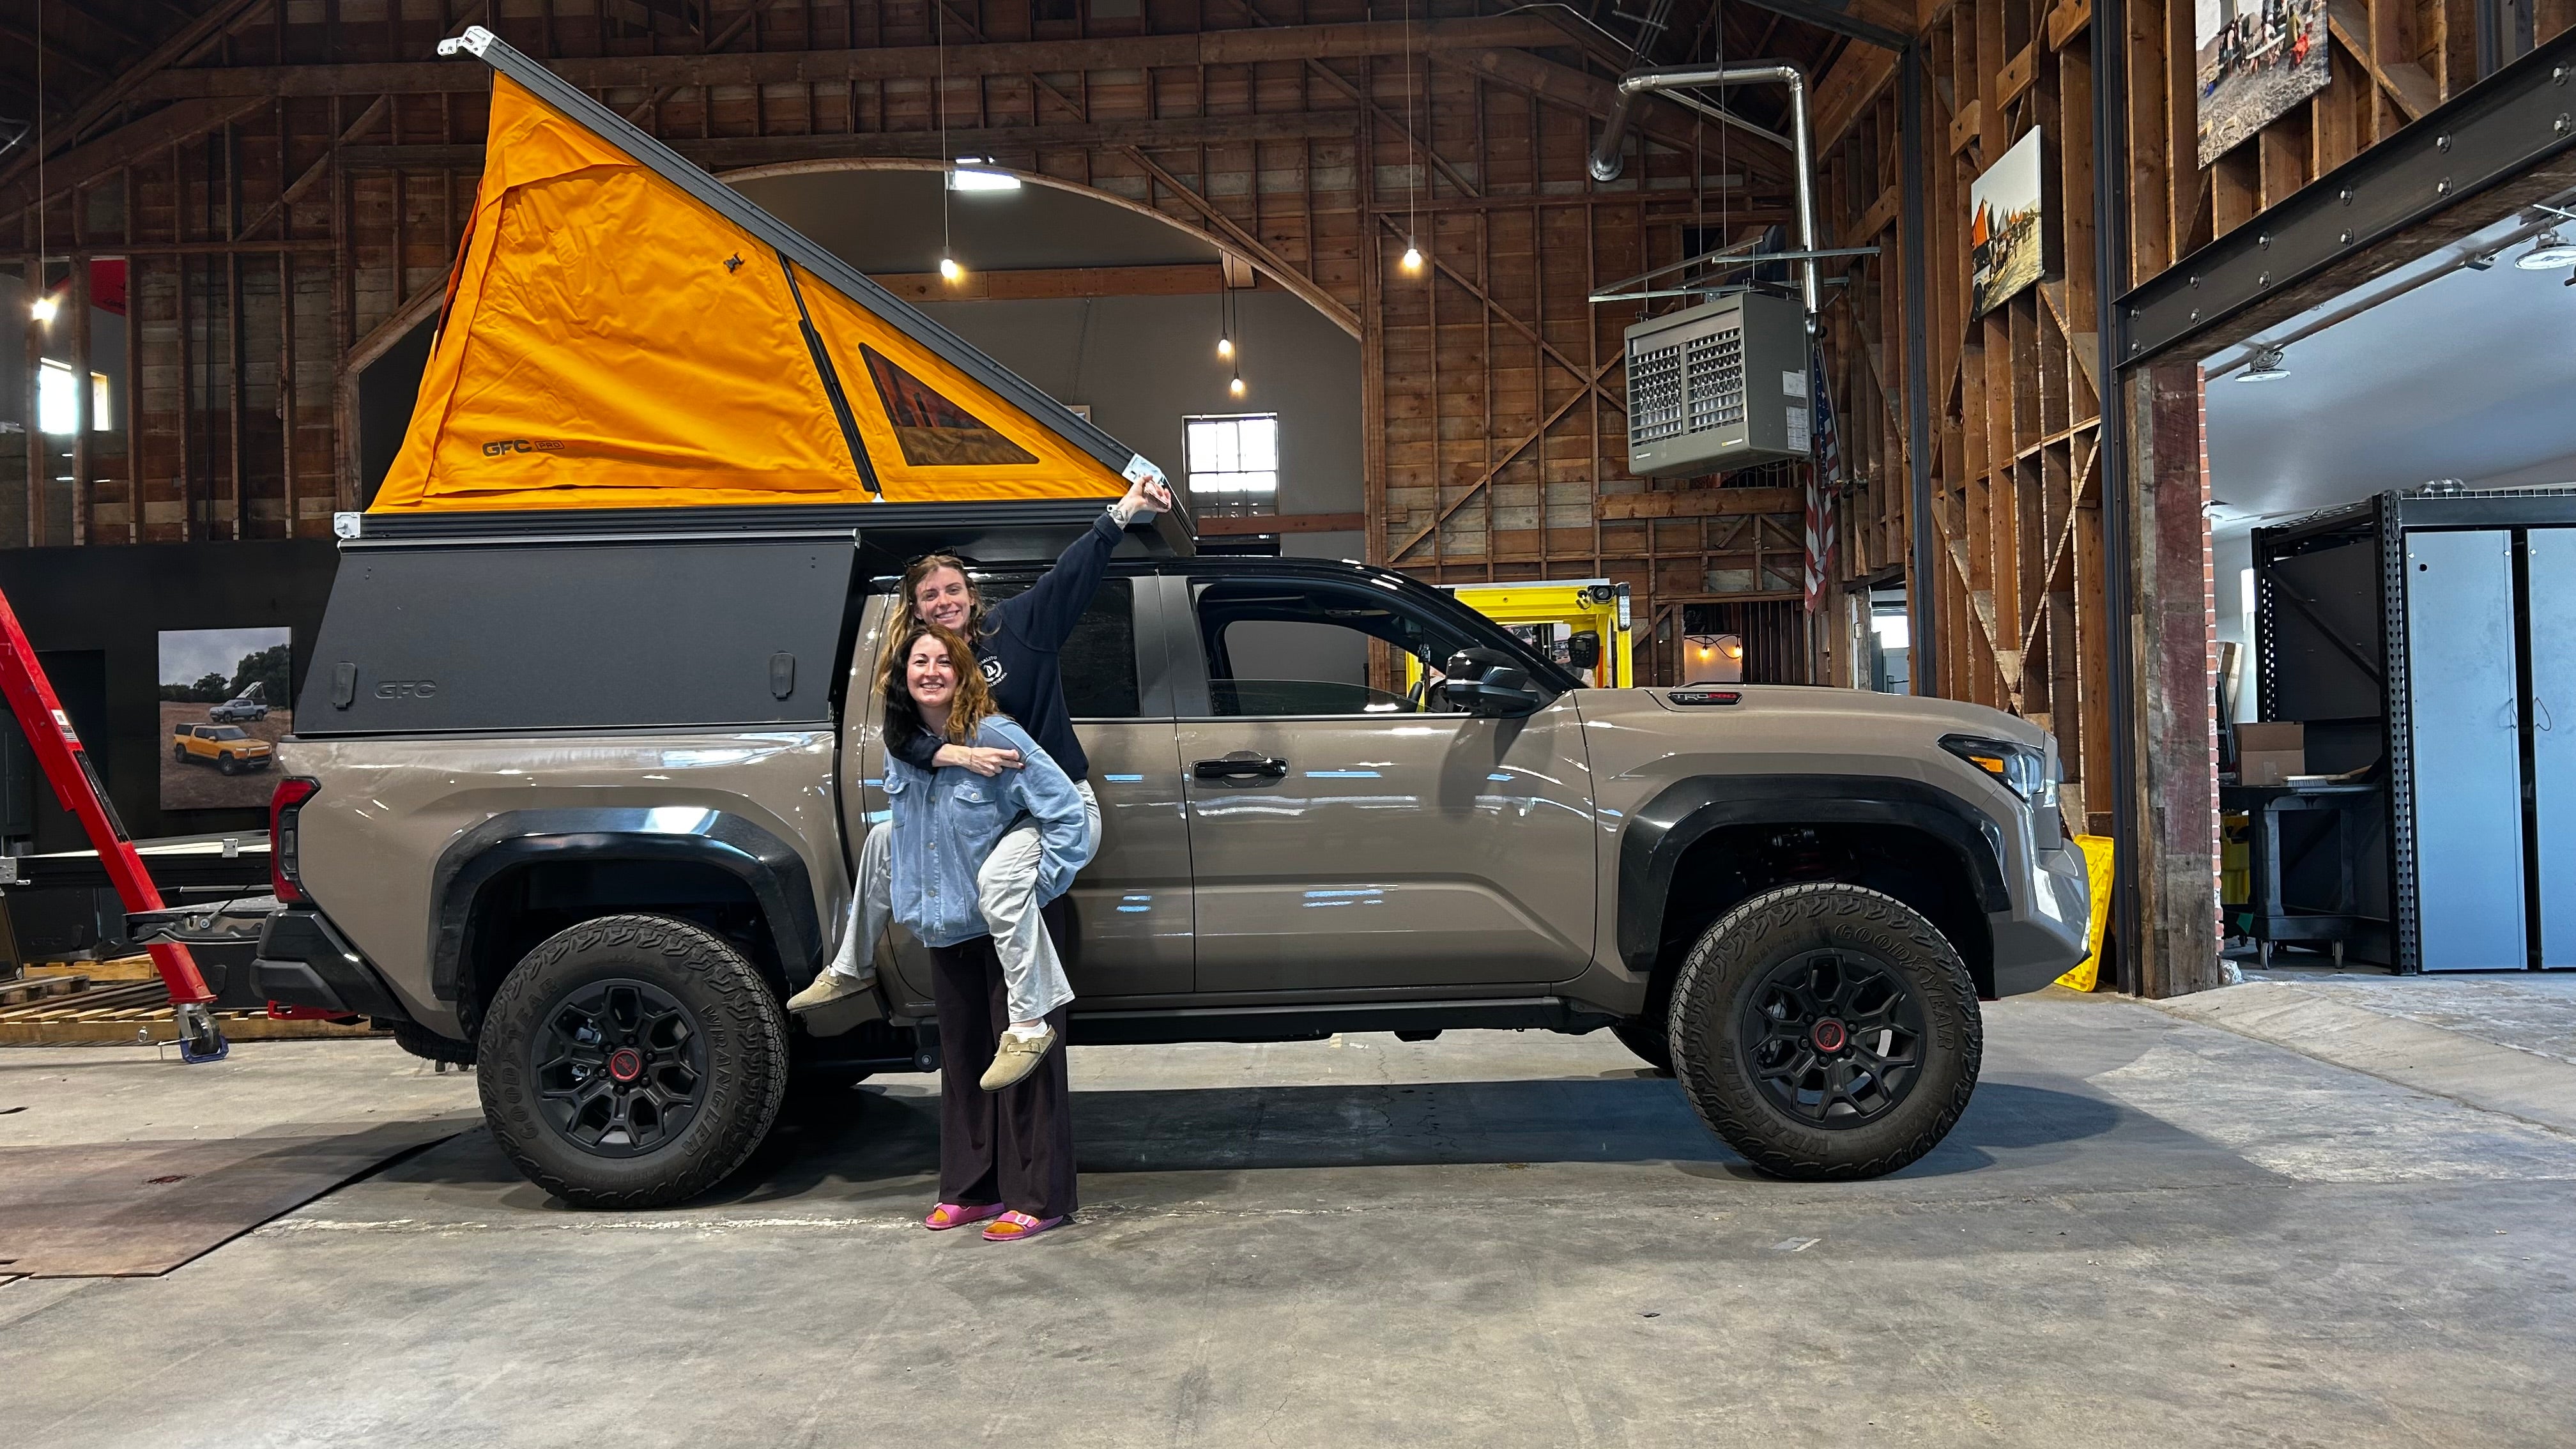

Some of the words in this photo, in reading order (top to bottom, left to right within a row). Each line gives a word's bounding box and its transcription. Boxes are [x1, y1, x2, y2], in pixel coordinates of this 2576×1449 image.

[482, 440, 532, 457] GFC
[537, 440, 562, 449] PRO
[374, 680, 436, 699] GFC
[1834, 923, 1955, 1050] GOODYEAR
[682, 1004, 731, 1156] WRANGLER
[1723, 1038, 1828, 1156] WRANGLER
